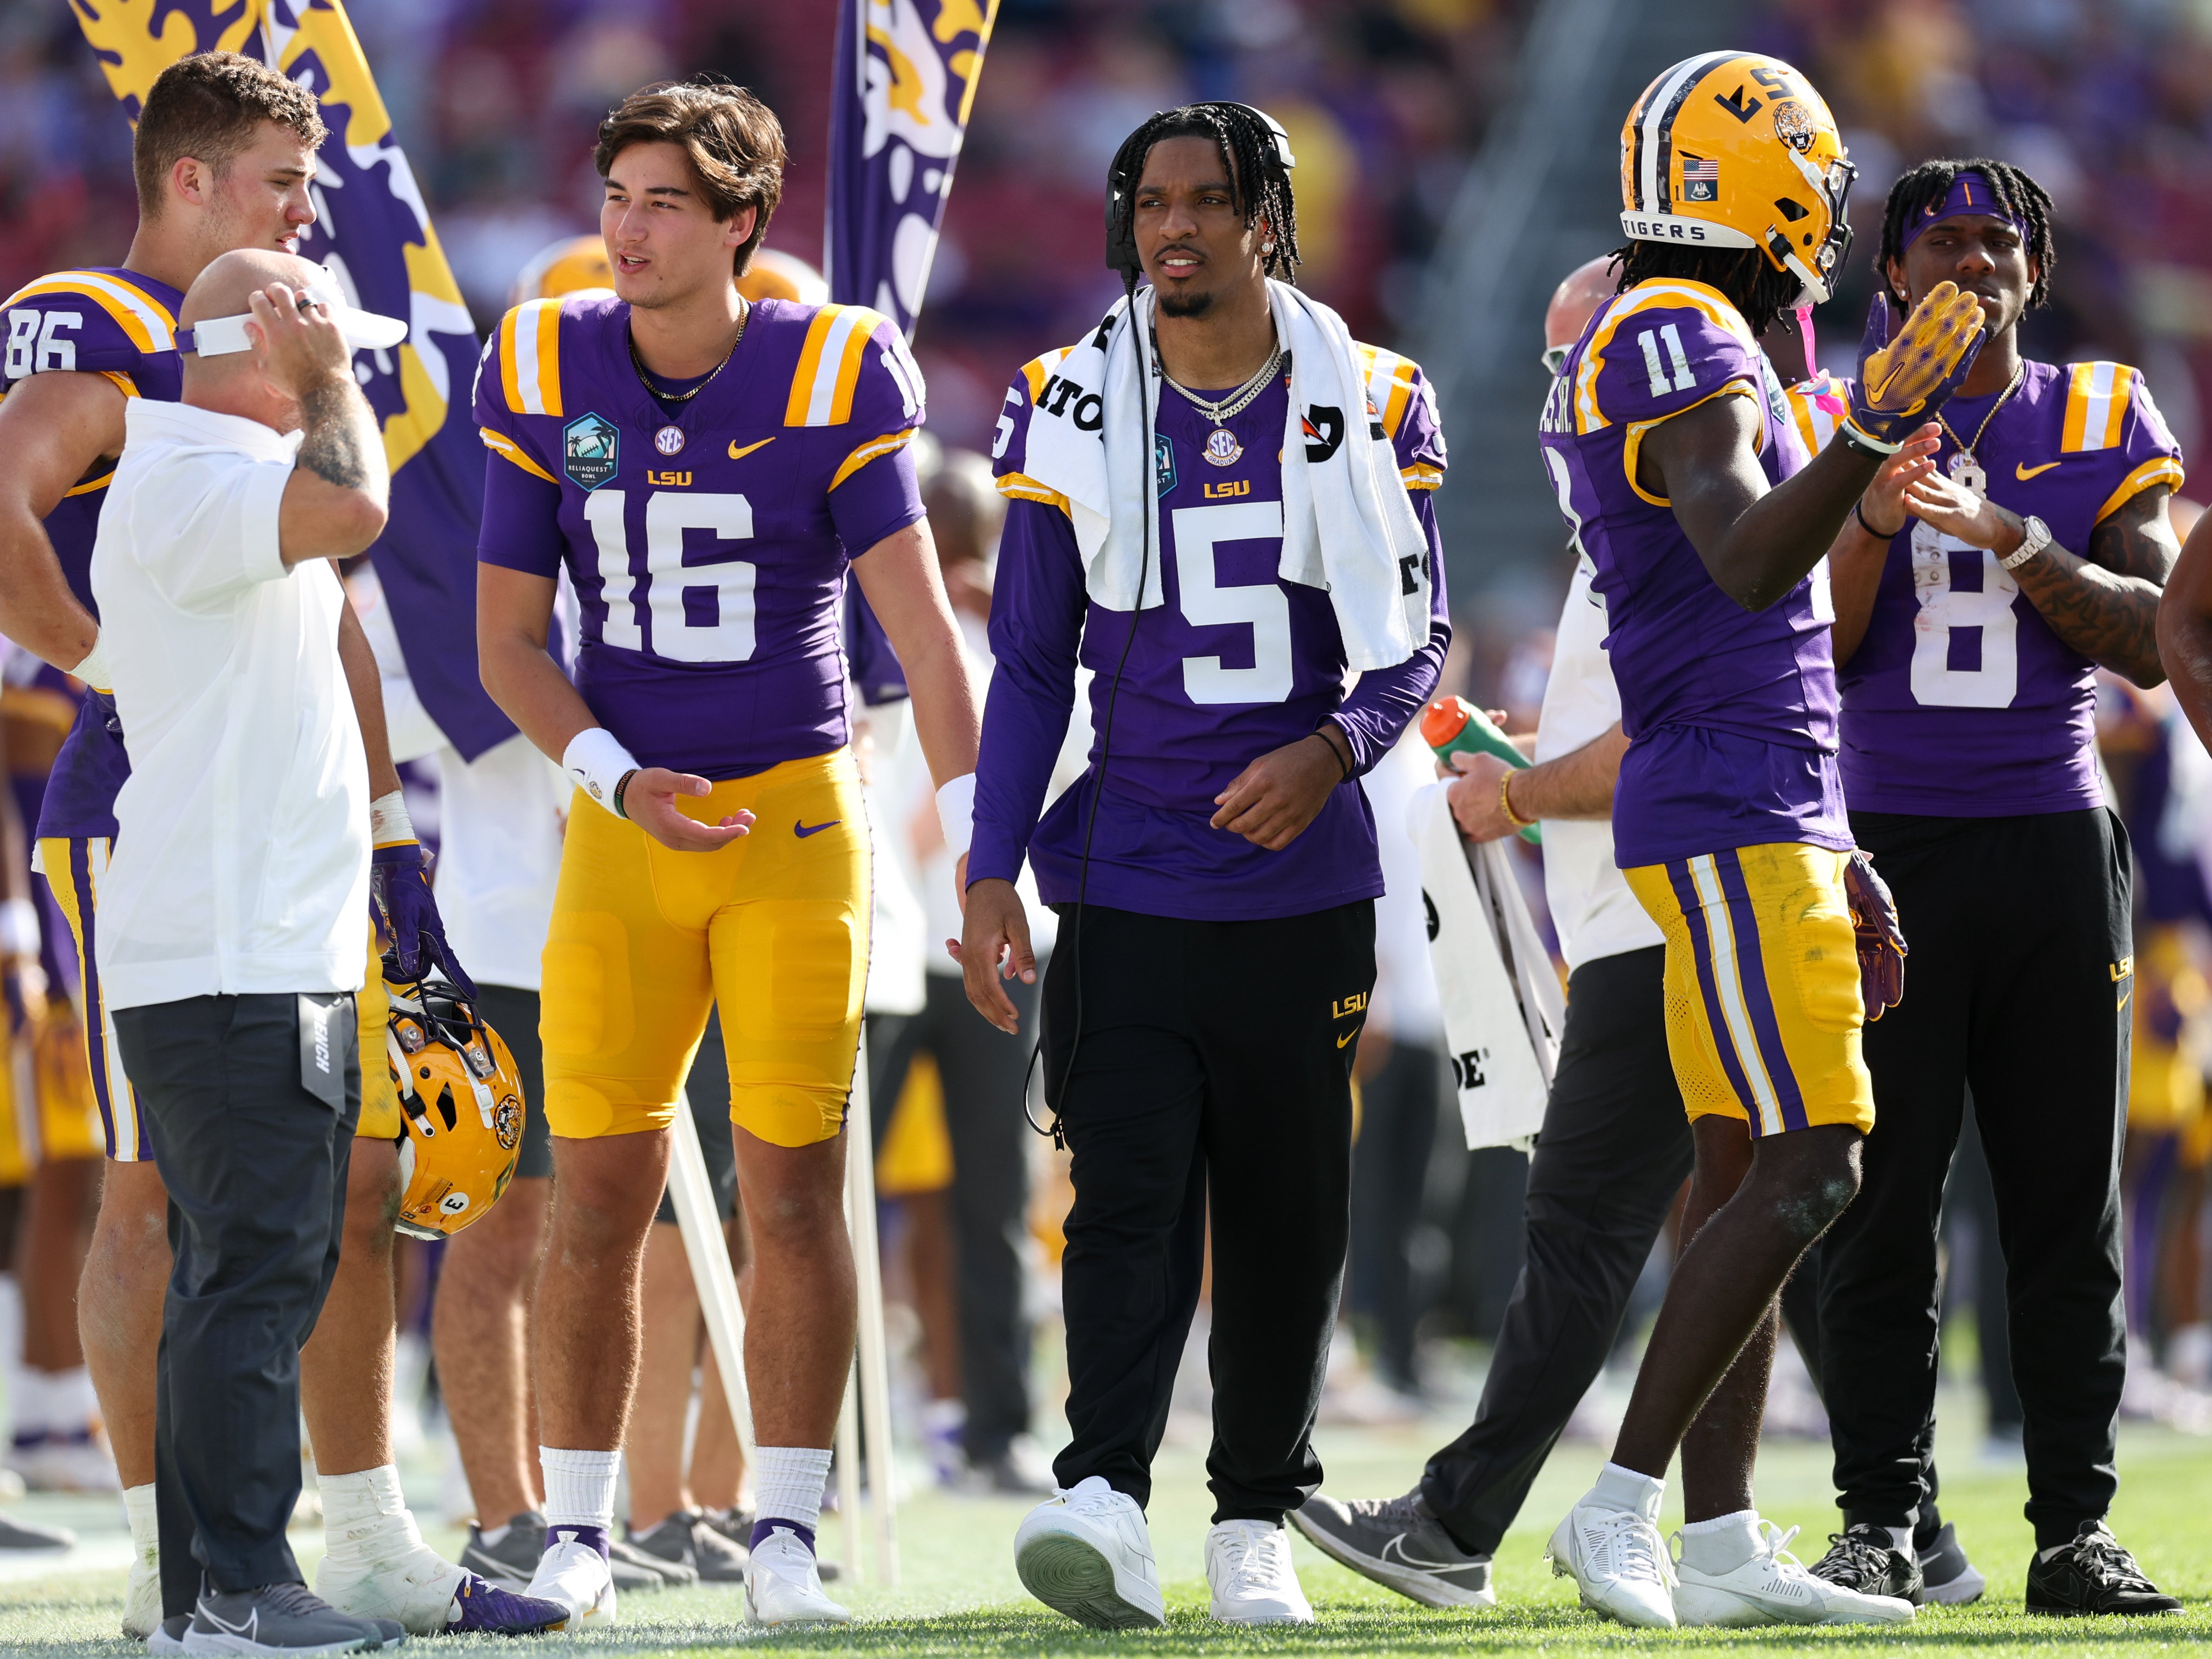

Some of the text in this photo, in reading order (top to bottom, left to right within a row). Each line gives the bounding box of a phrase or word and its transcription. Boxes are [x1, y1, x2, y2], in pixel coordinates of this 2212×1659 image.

[1714, 68, 1795, 124] LS
[1623, 220, 1705, 240] TIGERS
[5, 309, 83, 379] 86
[1637, 323, 1697, 398] 11
[658, 428, 682, 453] SEC
[1209, 431, 1235, 457] SEC
[1208, 453, 1239, 465] GRADUATE
[647, 469, 692, 486] LSU
[1203, 480, 1250, 498] LSU
[584, 489, 757, 663] 16
[1171, 501, 1294, 704] 5
[1910, 517, 2019, 708] 8
[617, 770, 635, 795] ENOUGH
[1332, 991, 1367, 1019] LSU
[313, 1008, 330, 1074] BENCH
[435, 1187, 451, 1203] DANGER
[444, 1198, 464, 1210] 3
